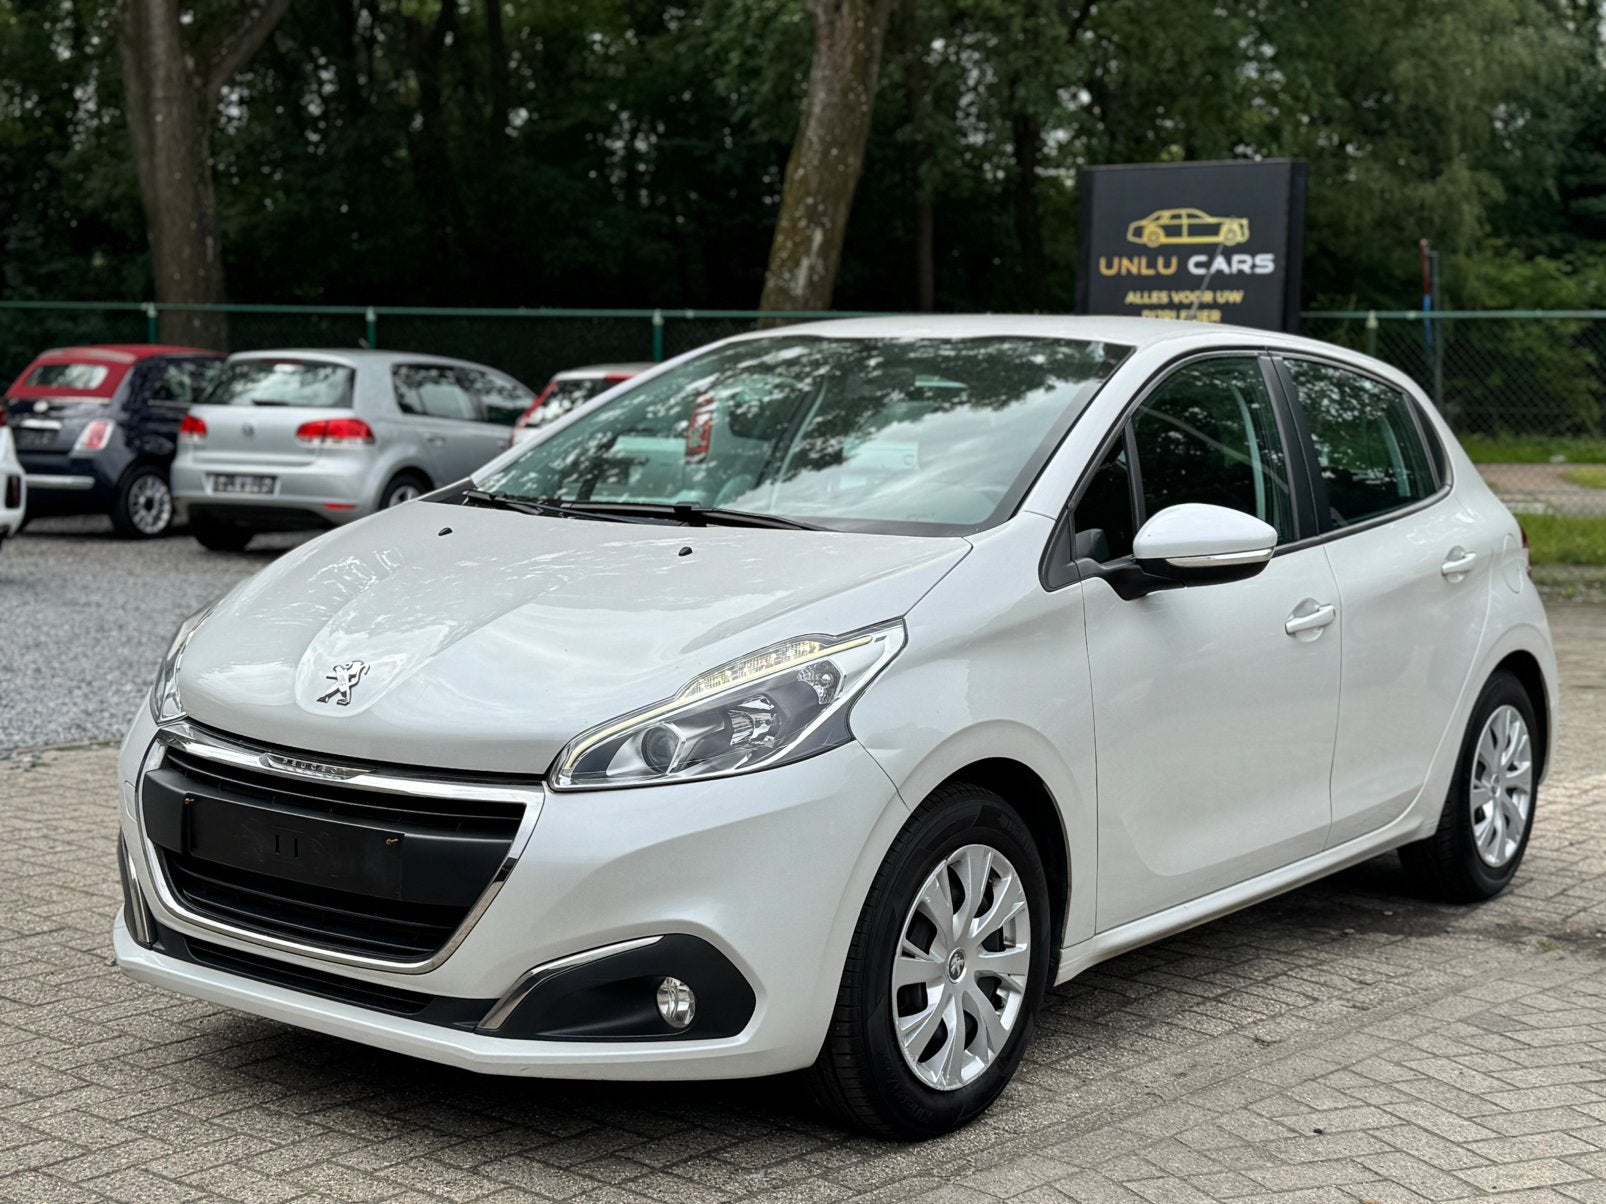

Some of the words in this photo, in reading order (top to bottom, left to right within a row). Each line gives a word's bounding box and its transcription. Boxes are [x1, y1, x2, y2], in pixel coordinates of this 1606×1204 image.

[1099, 255, 1178, 276] UNLU
[1187, 253, 1275, 275] CARS
[1124, 290, 1169, 305] ALLES
[1171, 289, 1214, 304] VOOR
[1216, 289, 1244, 304] UW
